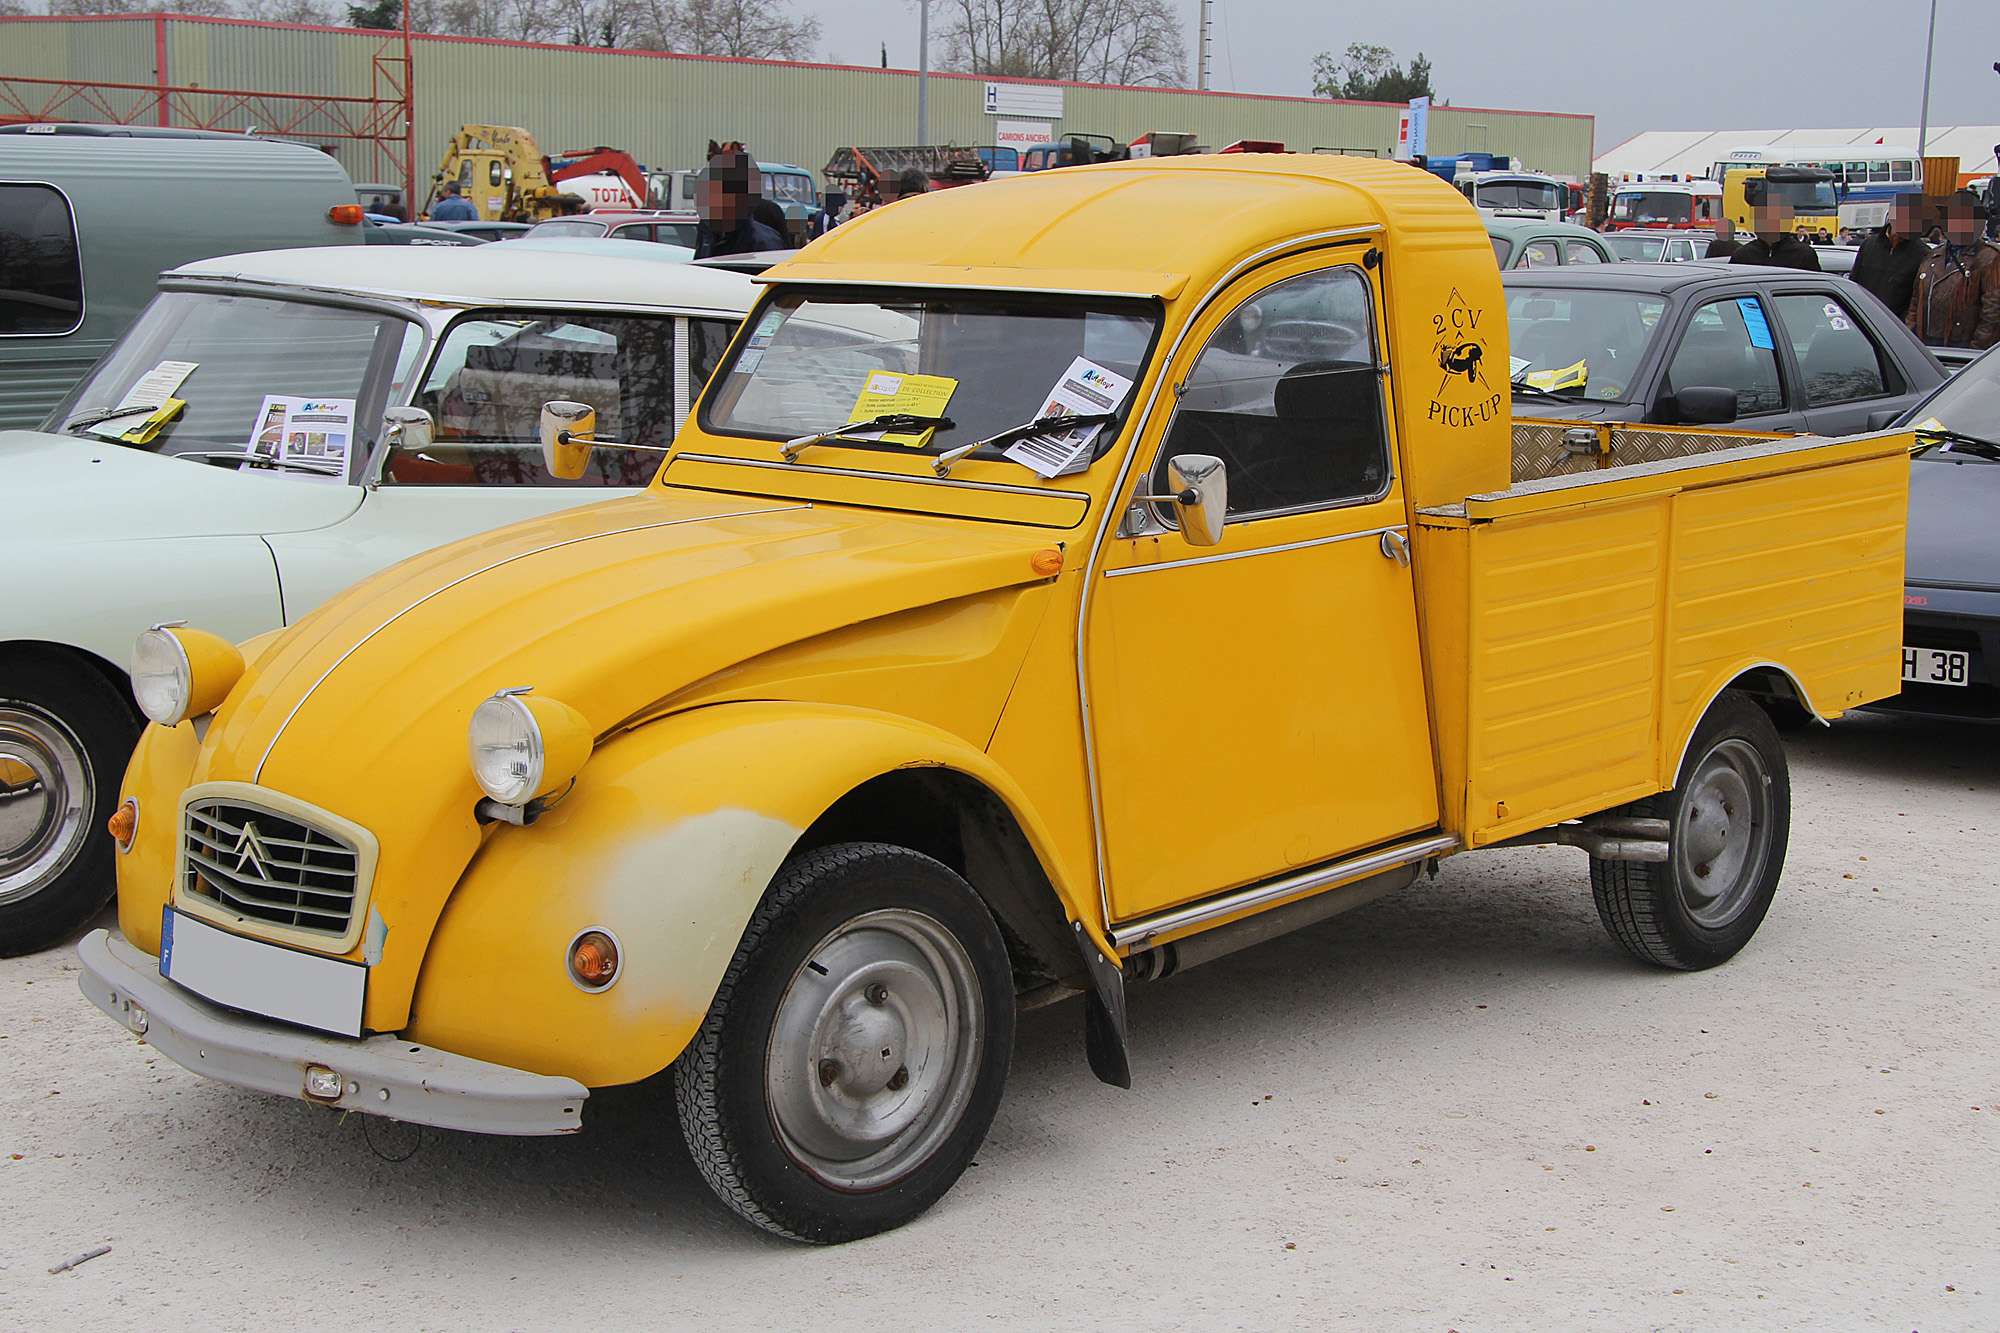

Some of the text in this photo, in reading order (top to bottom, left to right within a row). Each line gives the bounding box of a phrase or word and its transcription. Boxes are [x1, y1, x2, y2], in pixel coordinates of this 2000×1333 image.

[987, 86, 997, 103] H
[998, 132, 1050, 143] CAMIONS ANCIENS
[410, 238, 462, 246] SPORT
[1427, 393, 1502, 428] PICK-UP
[1930, 651, 1965, 683] 38
[163, 948, 170, 964] F
